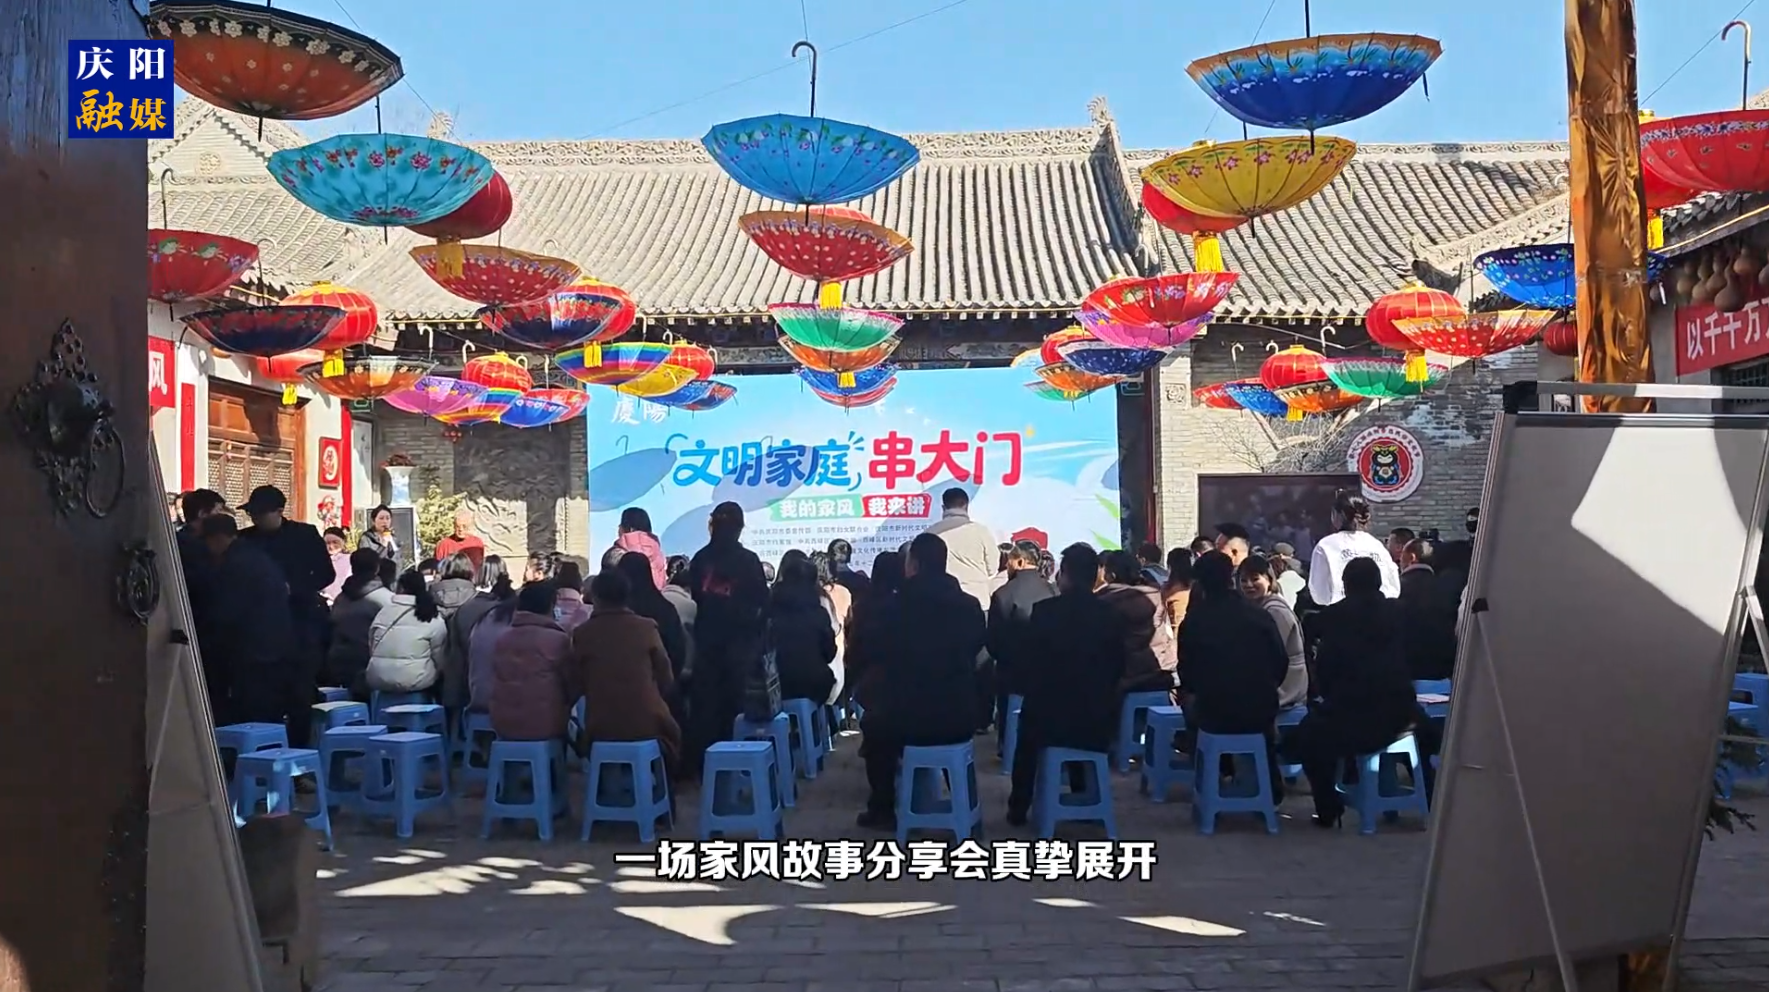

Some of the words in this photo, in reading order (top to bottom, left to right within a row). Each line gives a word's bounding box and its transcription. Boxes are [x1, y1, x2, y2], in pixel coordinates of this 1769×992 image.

[672, 437, 851, 488] 文明家庭
[868, 429, 1023, 489] 串大门
[779, 498, 855, 518] 我的家风
[867, 496, 926, 516] 我来讲
